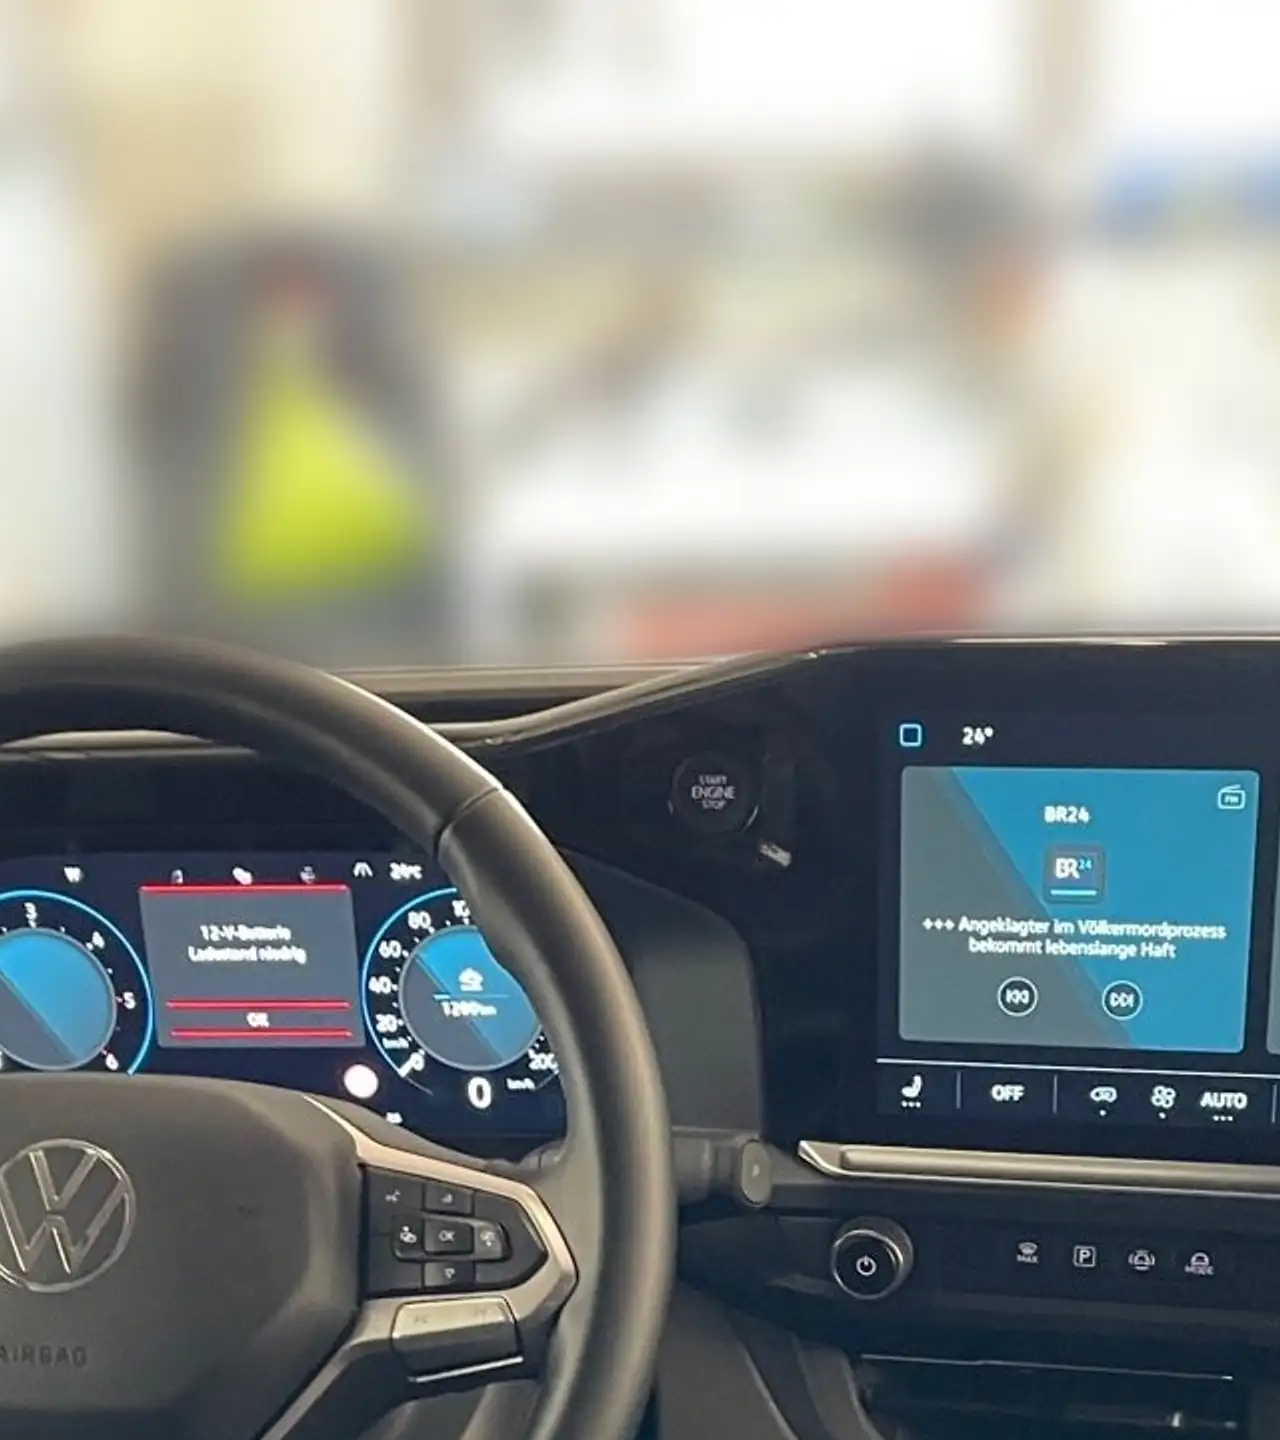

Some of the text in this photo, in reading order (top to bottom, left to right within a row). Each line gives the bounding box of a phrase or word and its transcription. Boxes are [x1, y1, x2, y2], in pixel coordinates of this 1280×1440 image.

[1044, 805, 1090, 823] BR24
[23, 902, 38, 920] 3
[407, 911, 433, 930] 80
[958, 915, 1050, 938] Angeklagter
[1053, 919, 1076, 935] im
[1077, 919, 1228, 941] Völkermordprozess
[92, 930, 106, 949] 4
[968, 936, 1178, 960] bekommt lebenslange Haft
[378, 940, 402, 958] 60
[123, 991, 136, 1009] 5
[376, 1014, 399, 1033] 20
[467, 1076, 493, 1109] 0
[990, 1084, 1025, 1101] OFF
[1200, 1091, 1248, 1110] AUTO
[438, 1230, 455, 1242] OK
[1079, 1250, 1091, 1264] P
